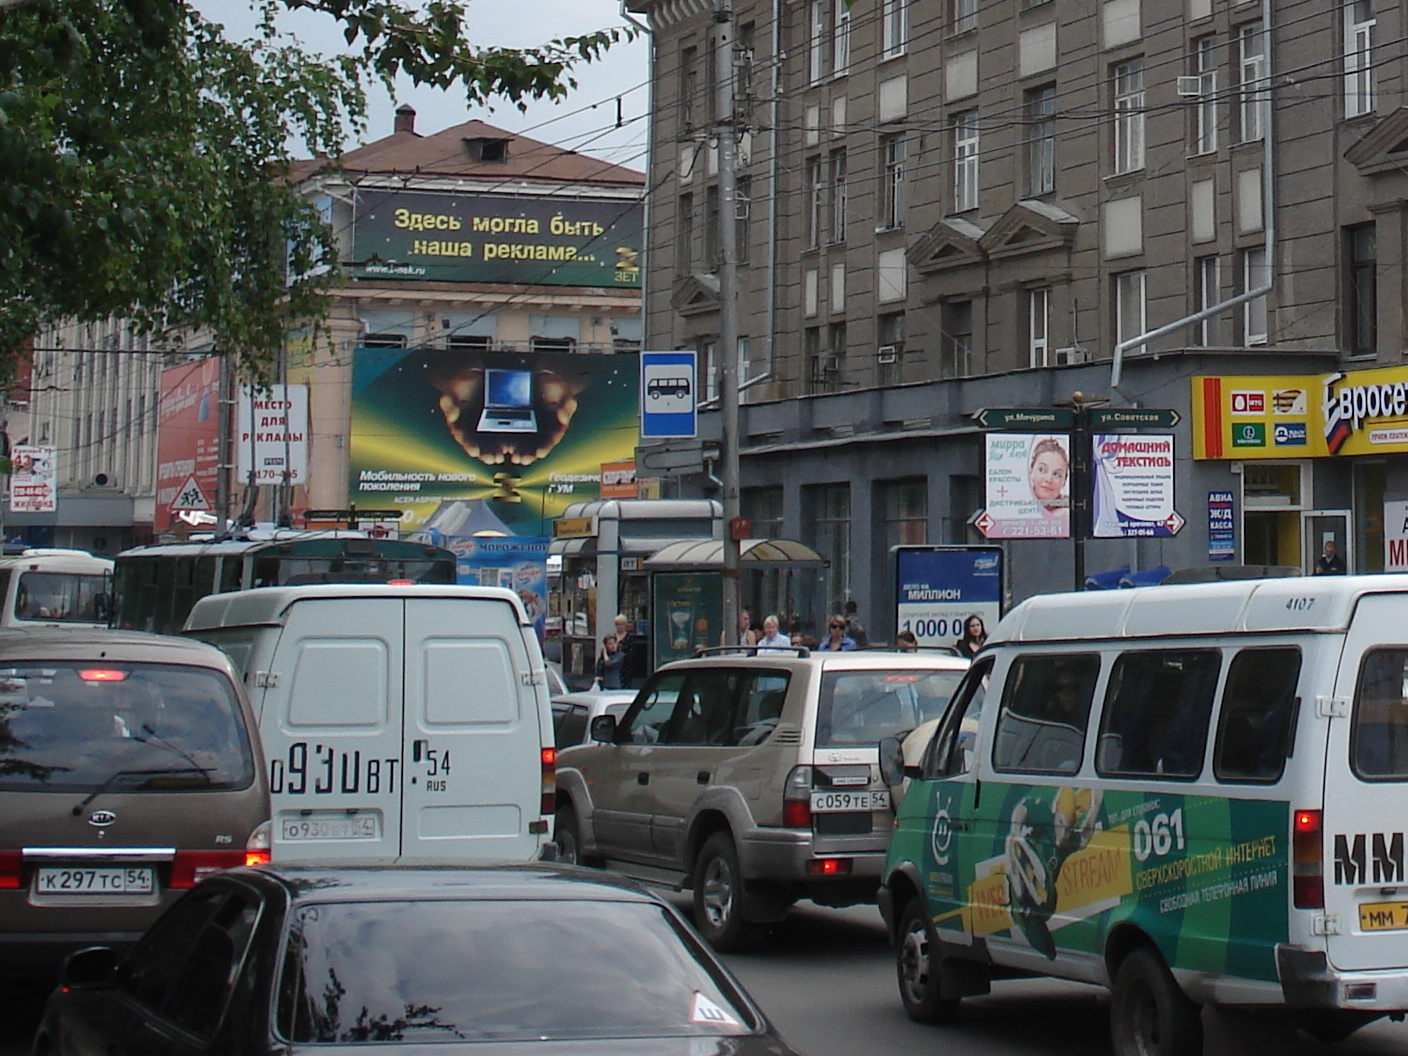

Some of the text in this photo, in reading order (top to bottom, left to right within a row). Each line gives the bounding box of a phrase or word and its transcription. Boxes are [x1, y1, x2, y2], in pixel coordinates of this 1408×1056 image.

[394, 208, 605, 237] Здесь могла быть
[413, 239, 596, 262] наша реклама...
[254, 400, 293, 411] МЕСТО
[260, 416, 287, 427] ДЛЯ
[242, 432, 303, 442] РКЛАМЫ
[1101, 440, 1171, 454] ДОМАШНИЙ
[1115, 456, 1172, 467] ТЕКСТИЛЬ
[359, 469, 477, 482] Мобильность нового
[359, 482, 421, 492] поколения
[1209, 493, 1233, 502] АВИА
[907, 589, 961, 601] МИЛЛИОН
[1286, 597, 1316, 610] 4107
[915, 619, 948, 638] 000
[427, 749, 451, 776] 54
[426, 780, 447, 792] RUS
[872, 793, 885, 804] 54
[215, 835, 233, 844] RS
[1133, 807, 1185, 861] 061
[1136, 835, 1276, 891] СВЕРХСКОРОСТНОЙ ИНТЕРНЕТ
[127, 870, 146, 884] 54
[1063, 847, 1121, 896] STREAM
[1160, 870, 1278, 914] СВОБОДНАЯ ТЕЛЕФОННАЯ ЛИНИЯ
[1369, 911, 1394, 927] ММ
